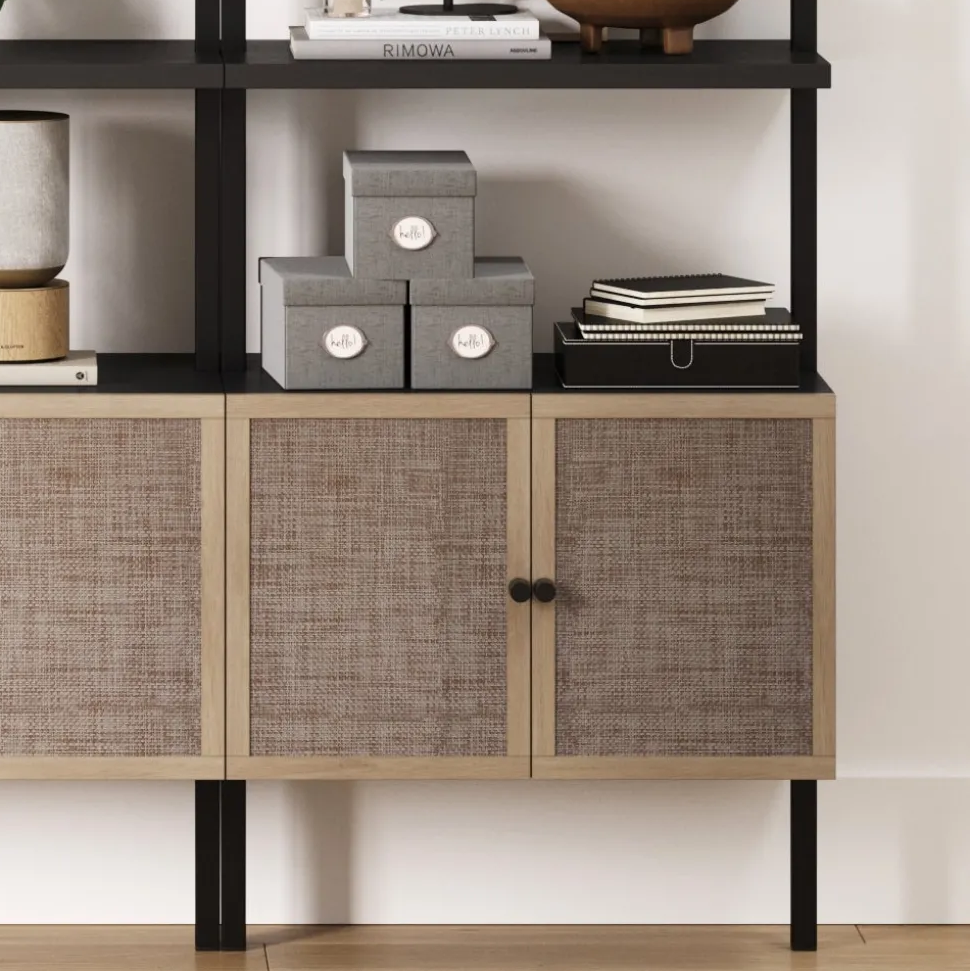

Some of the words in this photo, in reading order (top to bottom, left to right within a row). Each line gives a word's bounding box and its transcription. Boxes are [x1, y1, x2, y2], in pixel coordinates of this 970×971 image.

[445, 26, 485, 36] PETER
[489, 26, 530, 36] LYNCH
[383, 43, 455, 58] RIMOWA
[399, 225, 425, 240] hello!
[330, 334, 357, 349] hello!
[457, 334, 485, 349] hello!
